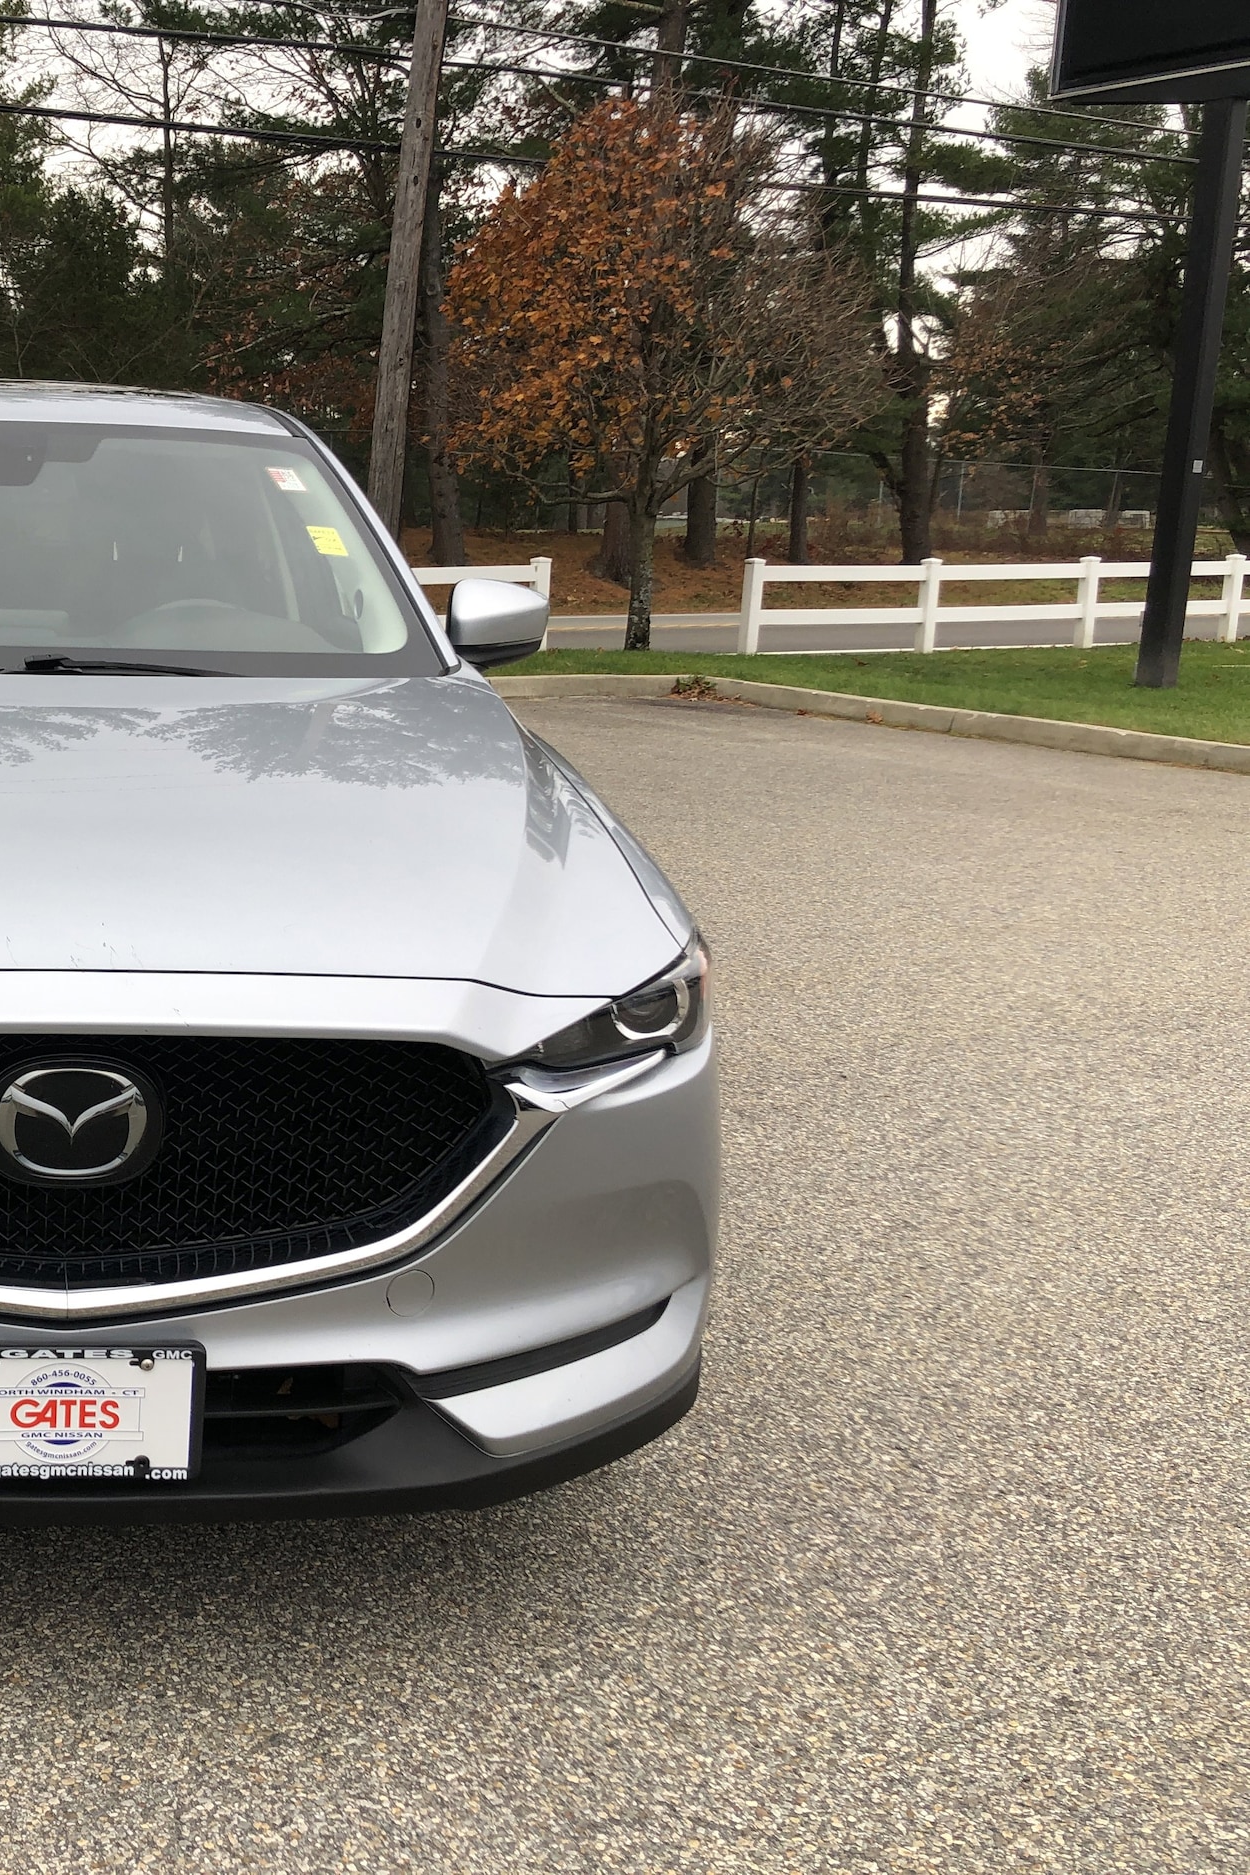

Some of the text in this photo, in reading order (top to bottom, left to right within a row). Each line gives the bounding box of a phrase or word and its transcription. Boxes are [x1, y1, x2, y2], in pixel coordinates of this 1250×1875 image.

[0, 1349, 134, 1359] GATES
[152, 1350, 193, 1360] GMC
[30, 1369, 97, 1386] 860-456-0055
[10, 1398, 120, 1429] GATES
[25, 1440, 98, 1460] gatesgmcnissan.com
